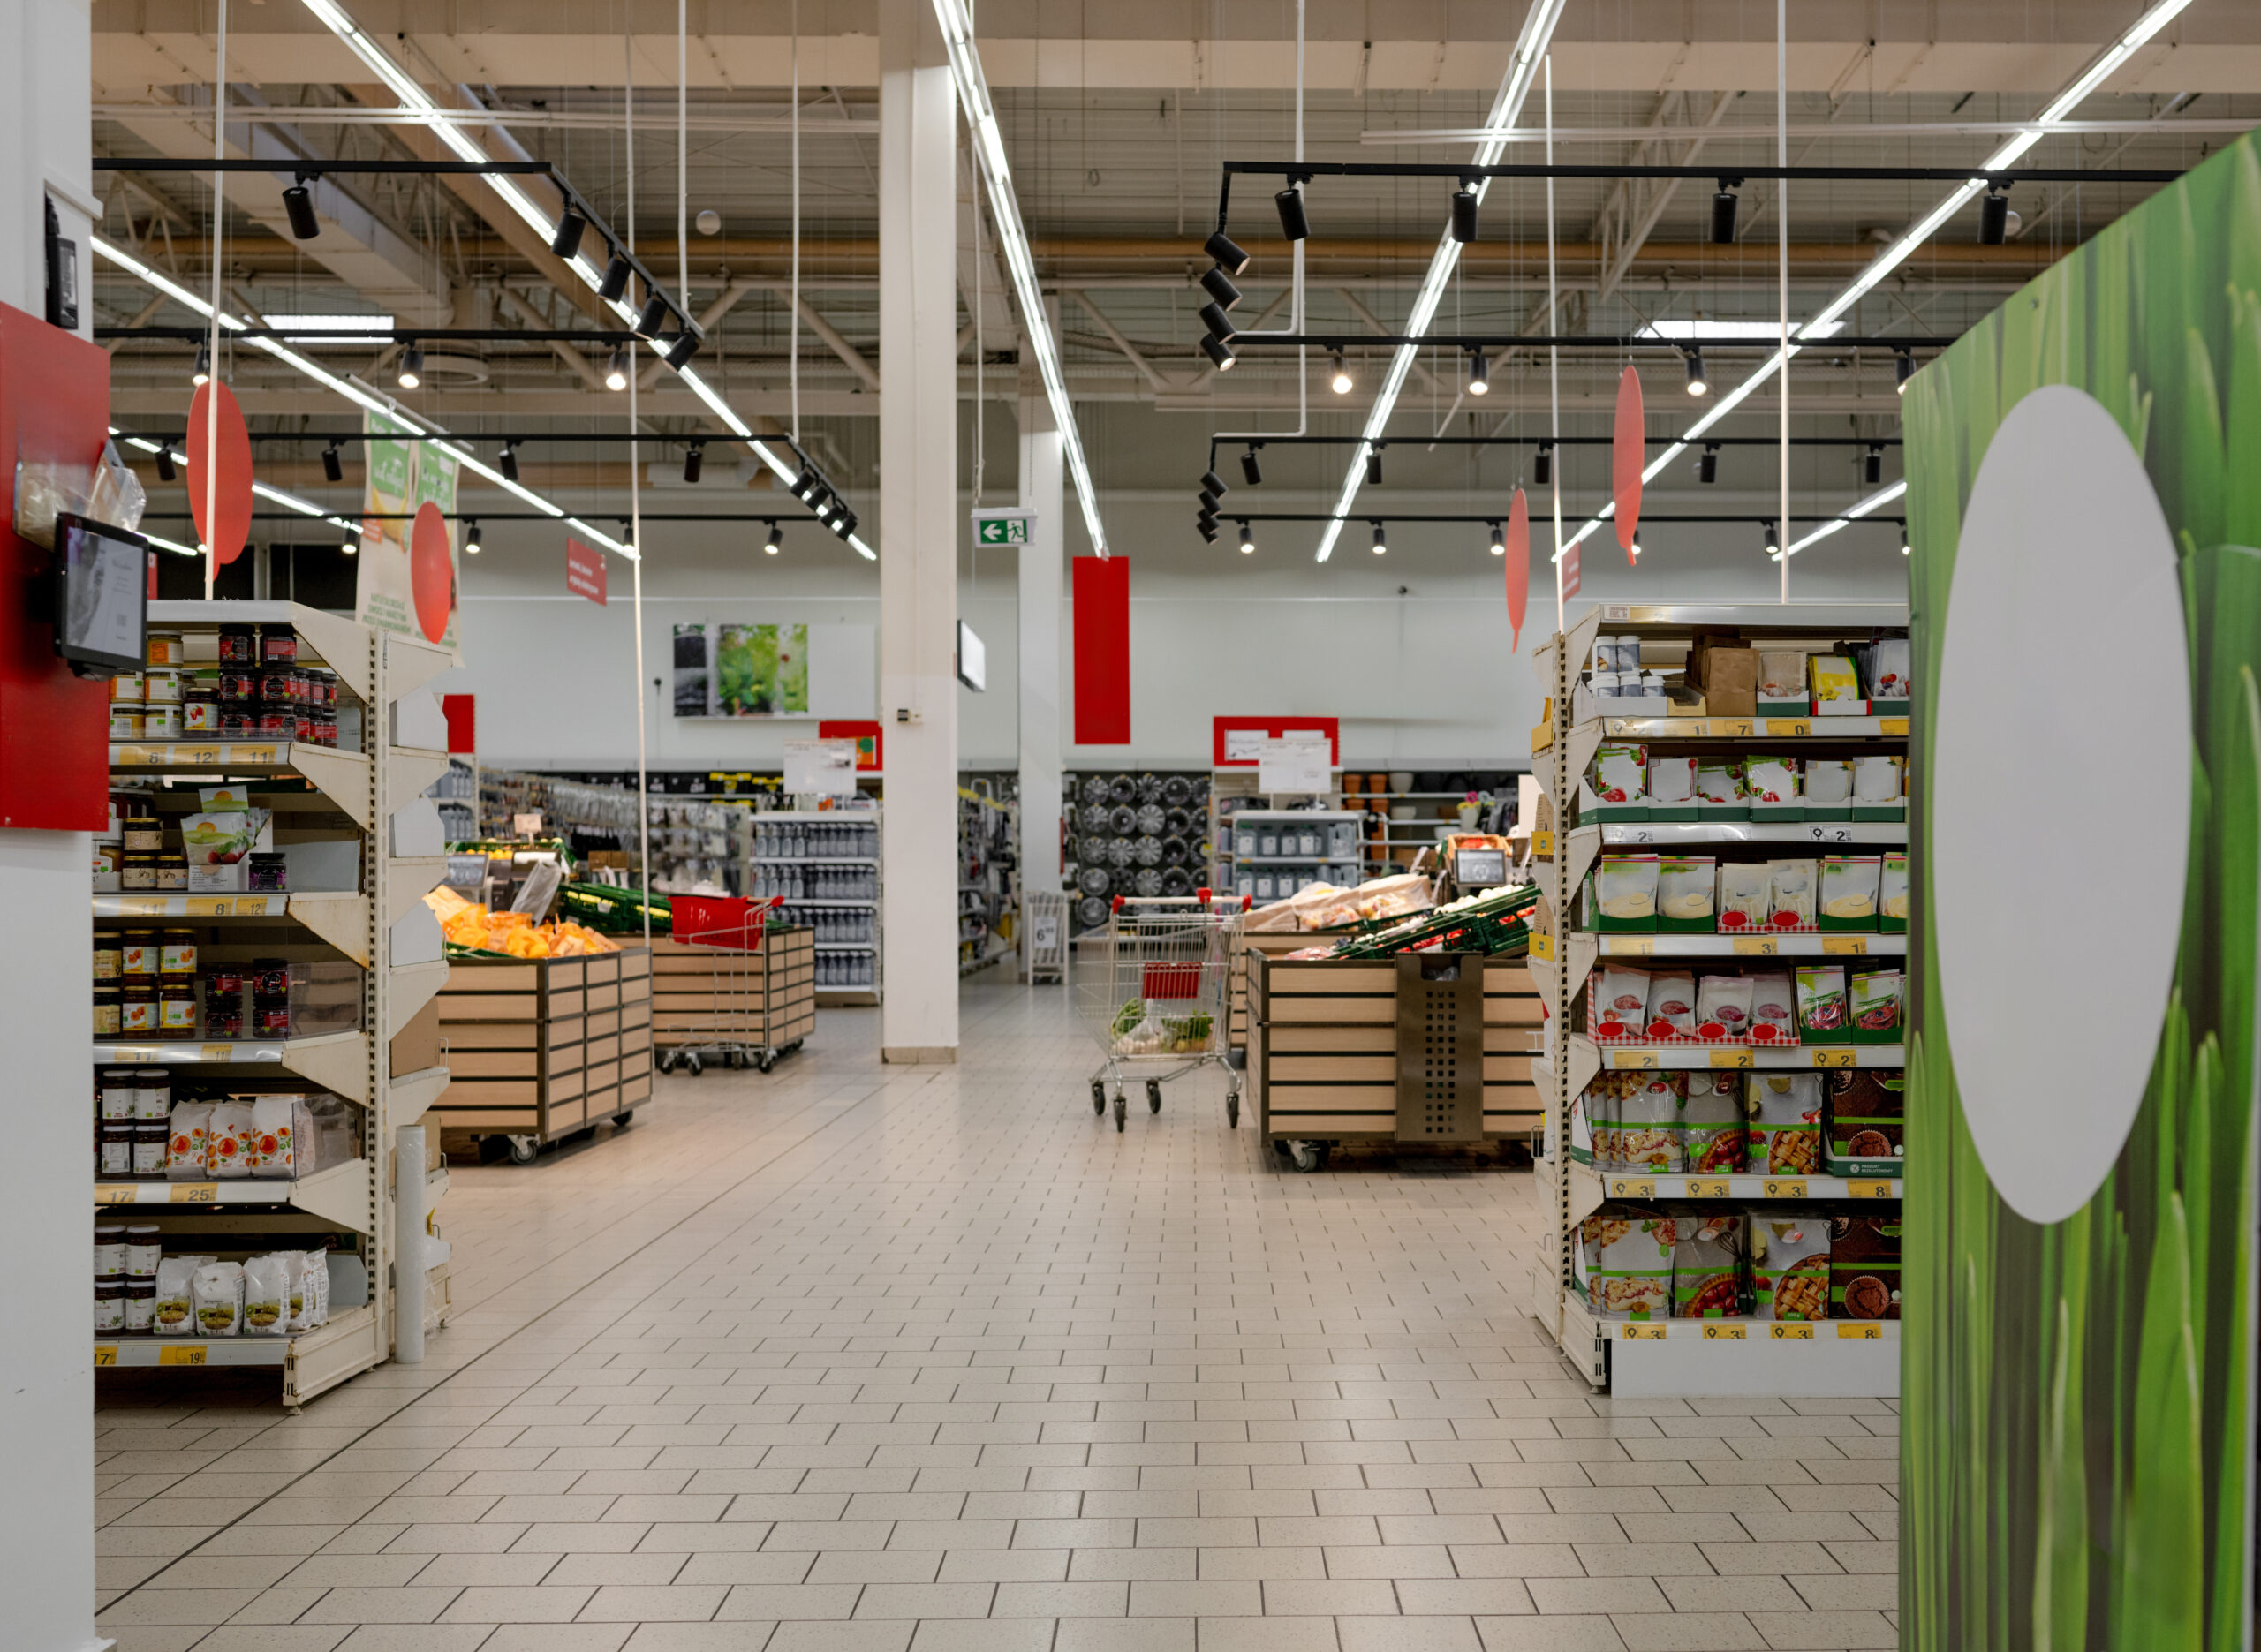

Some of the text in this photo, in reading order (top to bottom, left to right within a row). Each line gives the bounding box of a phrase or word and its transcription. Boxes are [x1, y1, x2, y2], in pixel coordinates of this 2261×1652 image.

[1692, 725, 1700, 735] 1
[1738, 725, 1748, 735] 7
[1795, 724, 1804, 735] 0
[149, 752, 159, 765] 8
[193, 751, 213, 764] 12
[249, 751, 268, 764] 11
[1637, 832, 1647, 842] 2
[1836, 831, 1846, 841] 2
[215, 903, 225, 916] 8
[250, 903, 261, 916] 12
[1036, 928, 1045, 941] 6
[1761, 943, 1771, 954] 3
[1851, 943, 1859, 954] 1
[1642, 1056, 1652, 1067] 2
[1738, 1056, 1748, 1067] 2
[1841, 1055, 1850, 1067] 2
[188, 1189, 210, 1202] 25
[1639, 1185, 1649, 1196] 3
[1713, 1186, 1724, 1196] 3
[1791, 1186, 1801, 1197] 3
[1876, 1186, 1886, 1197] 8
[110, 1191, 130, 1202] 17
[1651, 1330, 1660, 1339] 3
[1730, 1330, 1740, 1339] 3
[1798, 1329, 1808, 1339] 3
[1864, 1329, 1874, 1339] 8
[190, 1352, 200, 1364] 19
